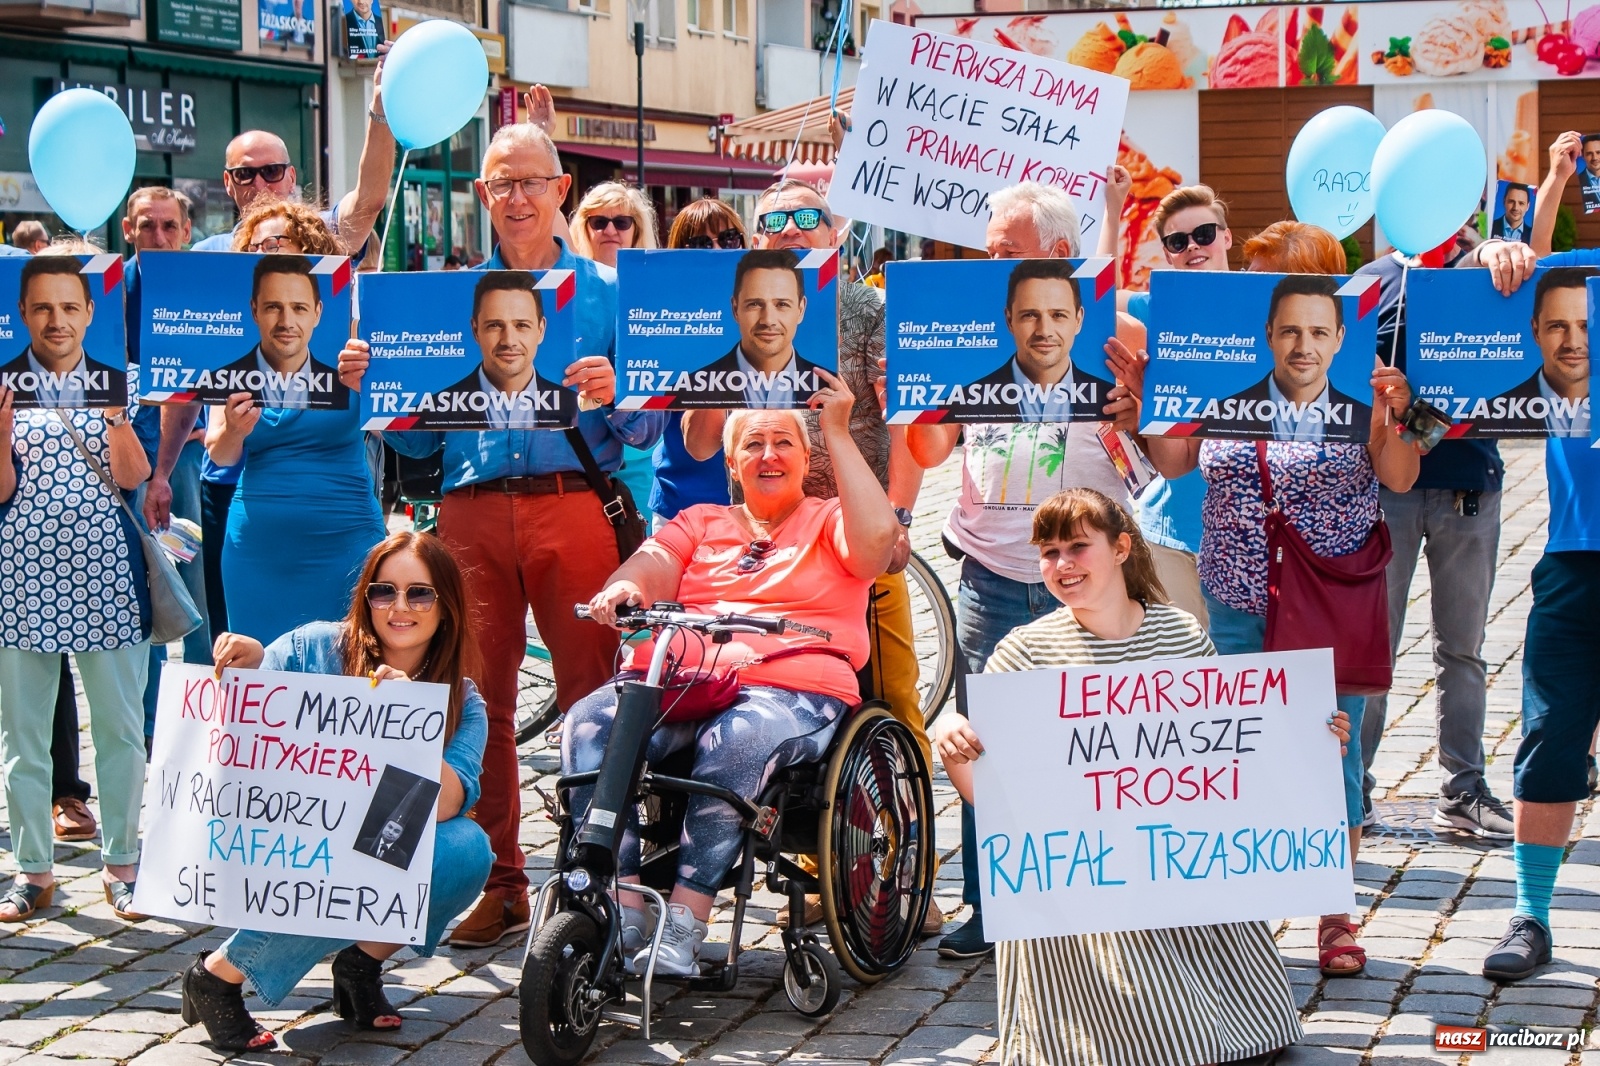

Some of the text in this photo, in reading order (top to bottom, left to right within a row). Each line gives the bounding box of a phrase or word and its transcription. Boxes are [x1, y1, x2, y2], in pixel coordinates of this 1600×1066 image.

[911, 32, 1099, 114] PIERWSZA DAMA
[502, 90, 513, 124] YWIEC
[877, 76, 1080, 150] W KĄCIE STAŁA
[867, 119, 1108, 200] O PRAWACH KOBIET
[851, 156, 905, 201] NIE
[151, 309, 242, 322] Silny Prezydent
[628, 309, 722, 321] Silny Prezydent
[152, 324, 244, 336] Wspólna Polska
[370, 330, 463, 344] Silny Prezydent
[628, 324, 724, 337] Wspólna Polska
[898, 320, 996, 334] Silny Prezydent
[898, 336, 998, 350] Wspólna Polska
[1158, 332, 1256, 347] Silny Prezydent
[1420, 332, 1522, 346] Silny Prezydent
[151, 357, 182, 366] RAFAŁ
[370, 346, 465, 358] Wspólna Polska
[1157, 348, 1256, 363] Wspólna Polska
[1420, 348, 1524, 362] Wspólna Polska
[627, 360, 659, 368] RAFAŁ
[1, 370, 110, 392] KOWSKI
[150, 368, 333, 393] TRZASKOWSKI
[370, 382, 402, 390] RAFAŁ
[626, 370, 820, 392] TRZASKOWSKI
[898, 374, 932, 382] RAFAŁ
[1154, 384, 1188, 394] RAFAŁ
[370, 390, 560, 412] TRZASKOWSKI
[897, 382, 1097, 406] TRZASKOWSKI
[1420, 386, 1454, 394] RAFAŁ
[1153, 396, 1353, 425] TRZASKOWSKI
[1059, 667, 1287, 719] LEKARSTWEM
[182, 676, 444, 742] KONIEC MARNEGO
[1068, 717, 1262, 765] NA NASZE
[208, 729, 377, 786] POLITYKIERA
[1083, 759, 1239, 811] TROSKI
[161, 769, 346, 831] W RACIBORZU
[207, 819, 333, 875] RAFAŁA
[981, 820, 1345, 896] RAFAŁ TRZASKOWSKI
[173, 865, 428, 942] SIĘ WSPIERA!
